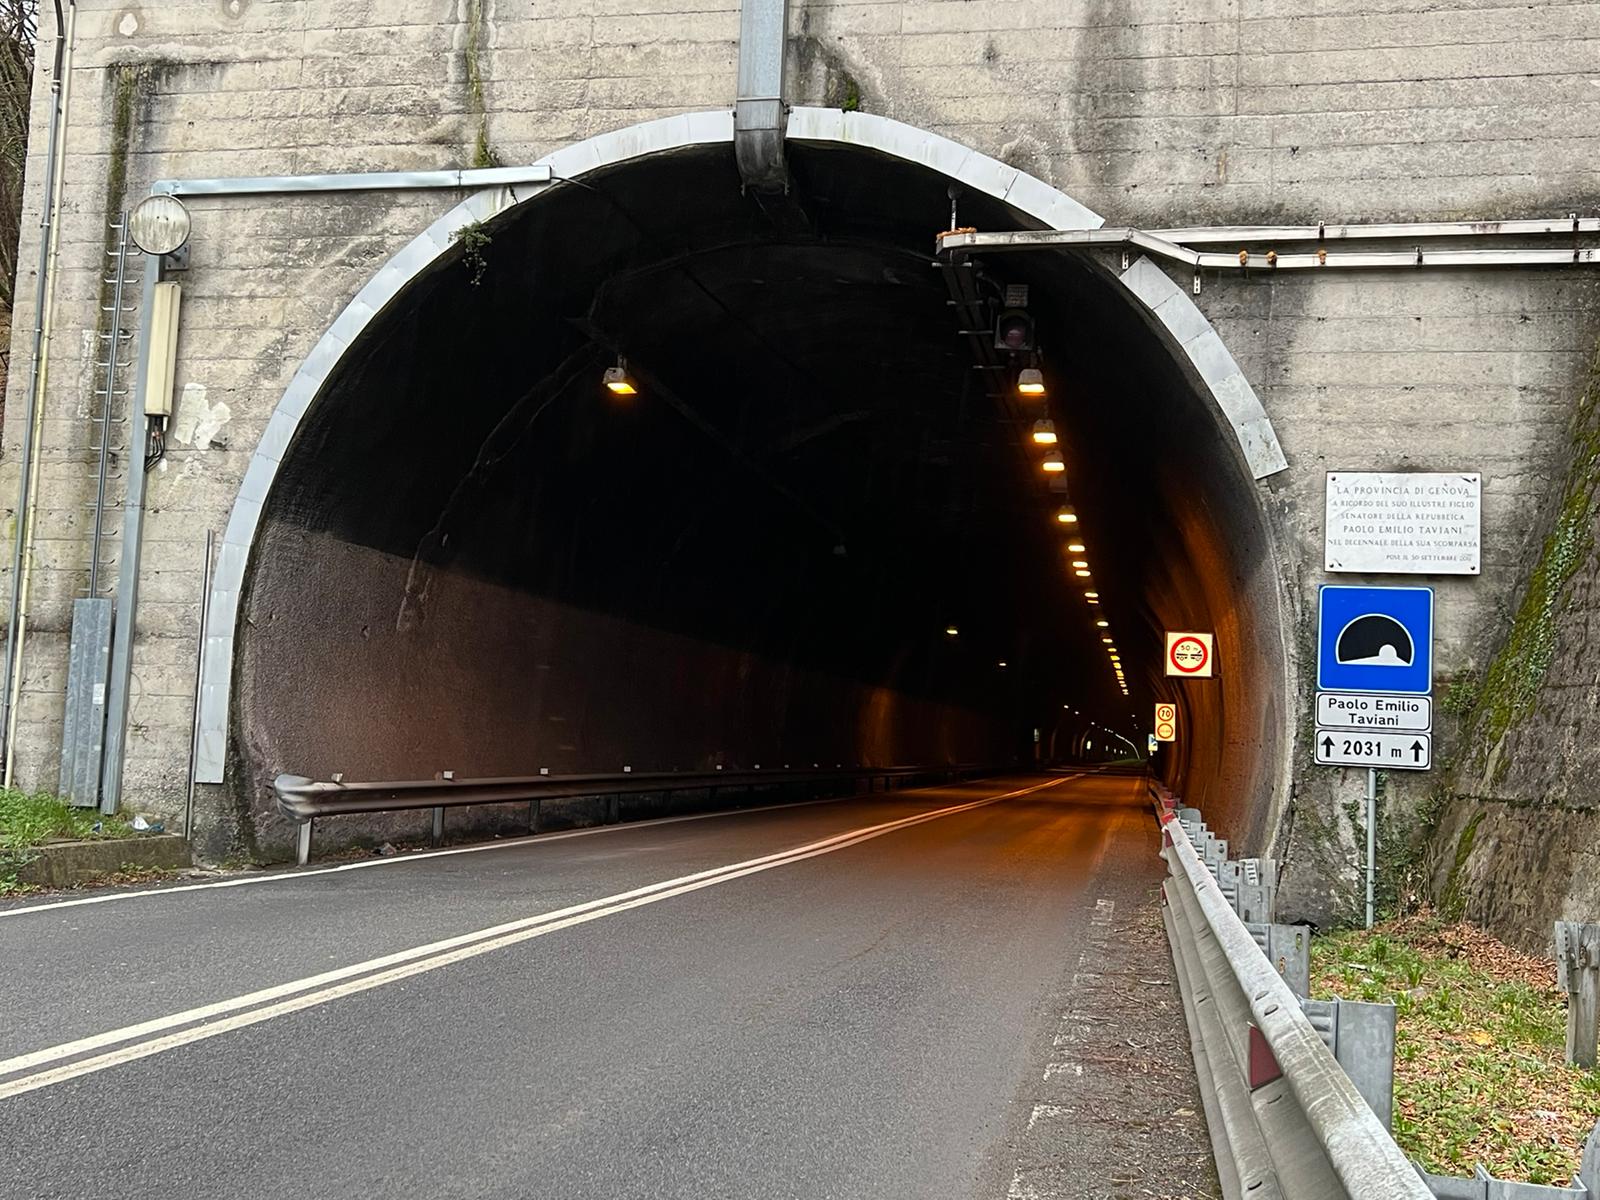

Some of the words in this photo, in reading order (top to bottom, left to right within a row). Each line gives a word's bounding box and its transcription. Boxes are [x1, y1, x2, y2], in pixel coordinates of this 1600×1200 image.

[1337, 486, 1349, 495] LA
[1354, 486, 1409, 495] PROVINCIA
[1415, 486, 1424, 495] DI
[1428, 487, 1470, 496] GENOVA
[1376, 500, 1389, 508] DEL
[1341, 512, 1383, 520] SENATORE
[1416, 513, 1465, 521] REPUBBLICA
[1343, 525, 1374, 534] PAOLO
[1379, 525, 1414, 534] EMILIO
[1419, 526, 1462, 535] TAVIANI
[1391, 539, 1413, 547] DELLA
[1433, 540, 1478, 548] SCOMPARSA
[1328, 698, 1368, 710] Paolo
[1375, 699, 1420, 712] Emilio
[1348, 713, 1399, 726] Taviani
[1343, 740, 1381, 757] 2031
[1391, 747, 1402, 758] m
